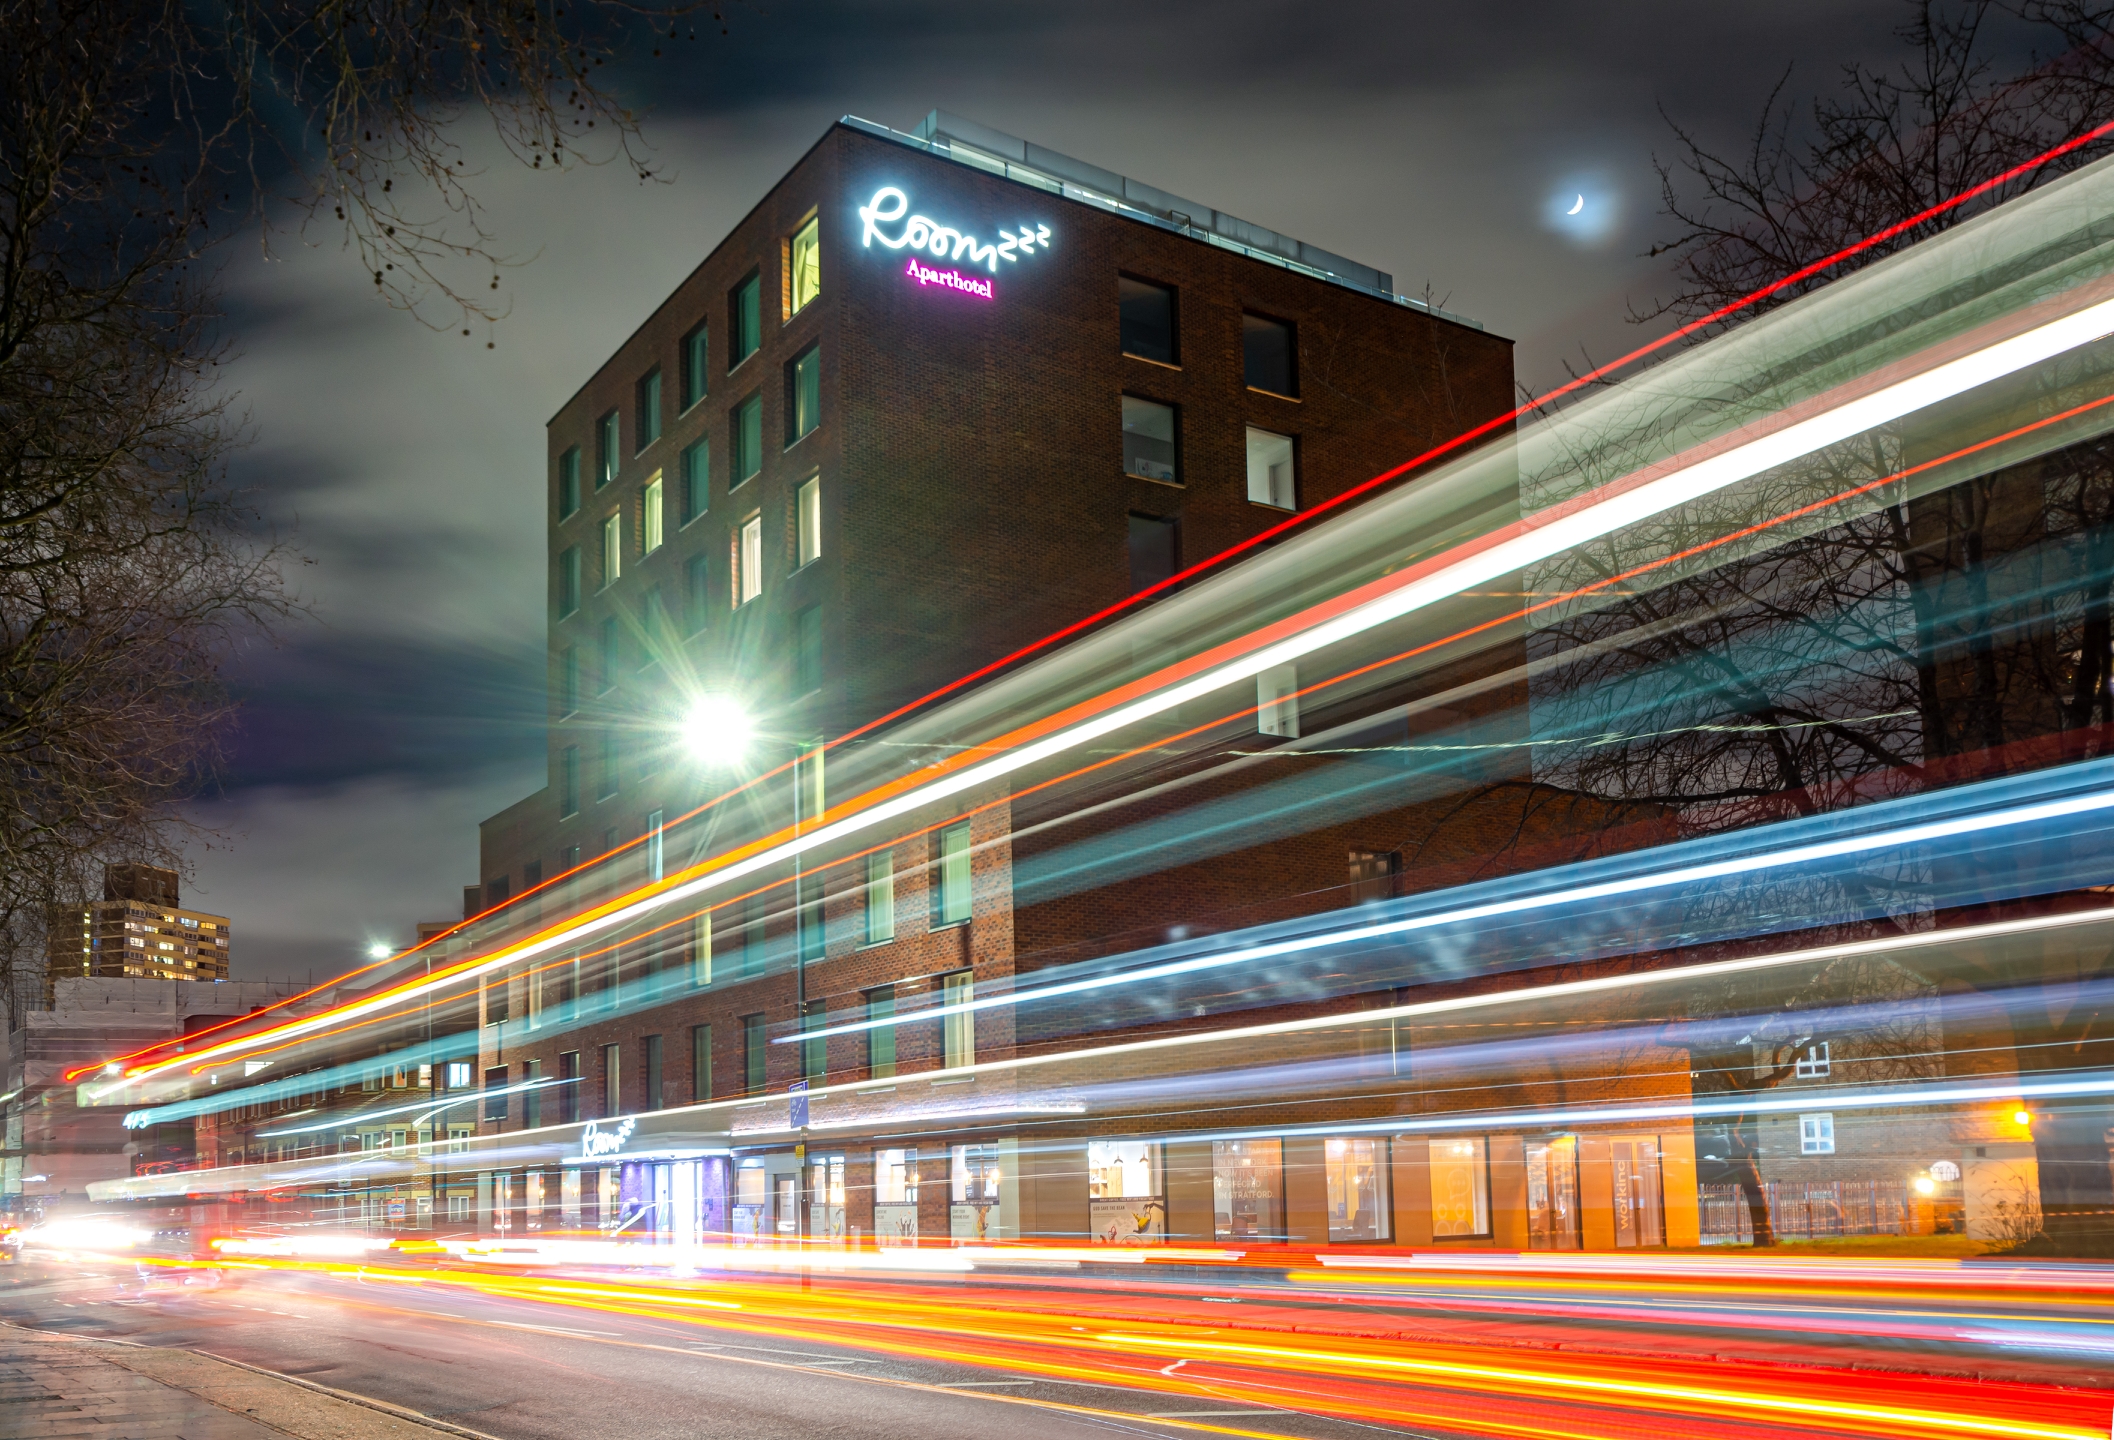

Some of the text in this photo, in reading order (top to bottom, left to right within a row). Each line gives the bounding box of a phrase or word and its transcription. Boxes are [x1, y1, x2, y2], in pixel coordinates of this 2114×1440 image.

[859, 187, 1051, 272] Roomzzz
[906, 258, 993, 299] Aparthotel
[1242, 1147, 1275, 1155] STARTED
[1218, 1170, 1237, 1178] NOW
[1254, 1169, 1274, 1177] BEEN
